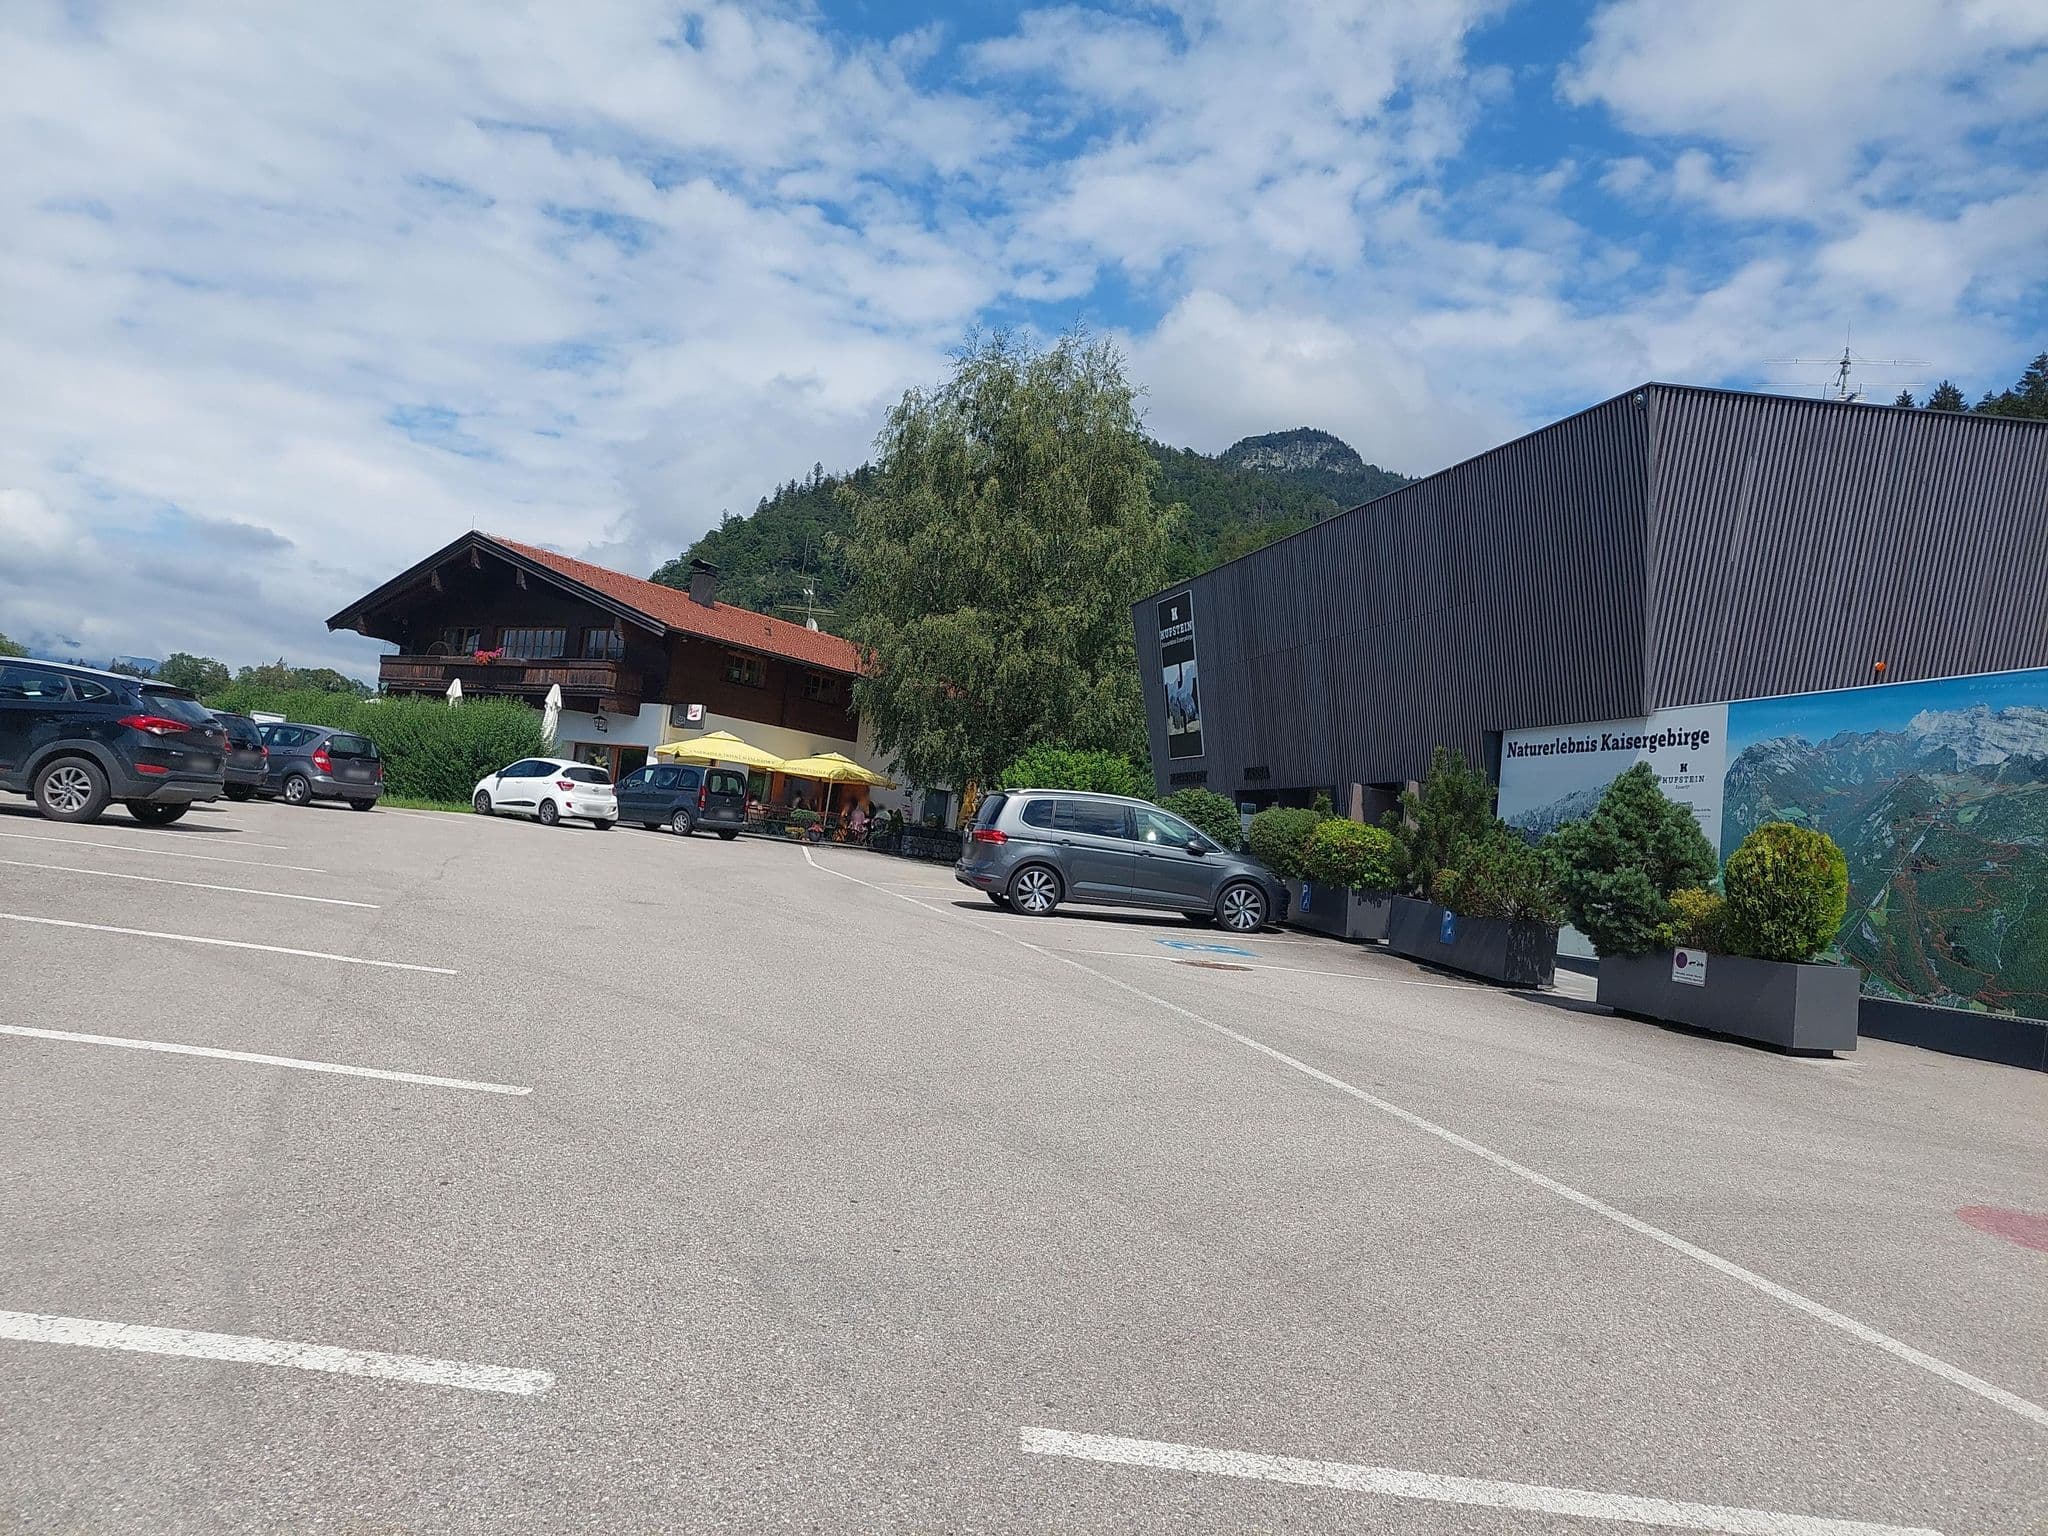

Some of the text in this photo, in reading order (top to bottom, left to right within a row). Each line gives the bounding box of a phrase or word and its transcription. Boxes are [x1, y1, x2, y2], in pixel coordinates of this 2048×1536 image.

[1160, 621, 1192, 640] KUFSTEIN
[1507, 727, 1710, 759] Naturerlebnis Kaisergebirge
[1662, 775, 1705, 784] KUFSTEIN
[1303, 885, 1308, 896] P
